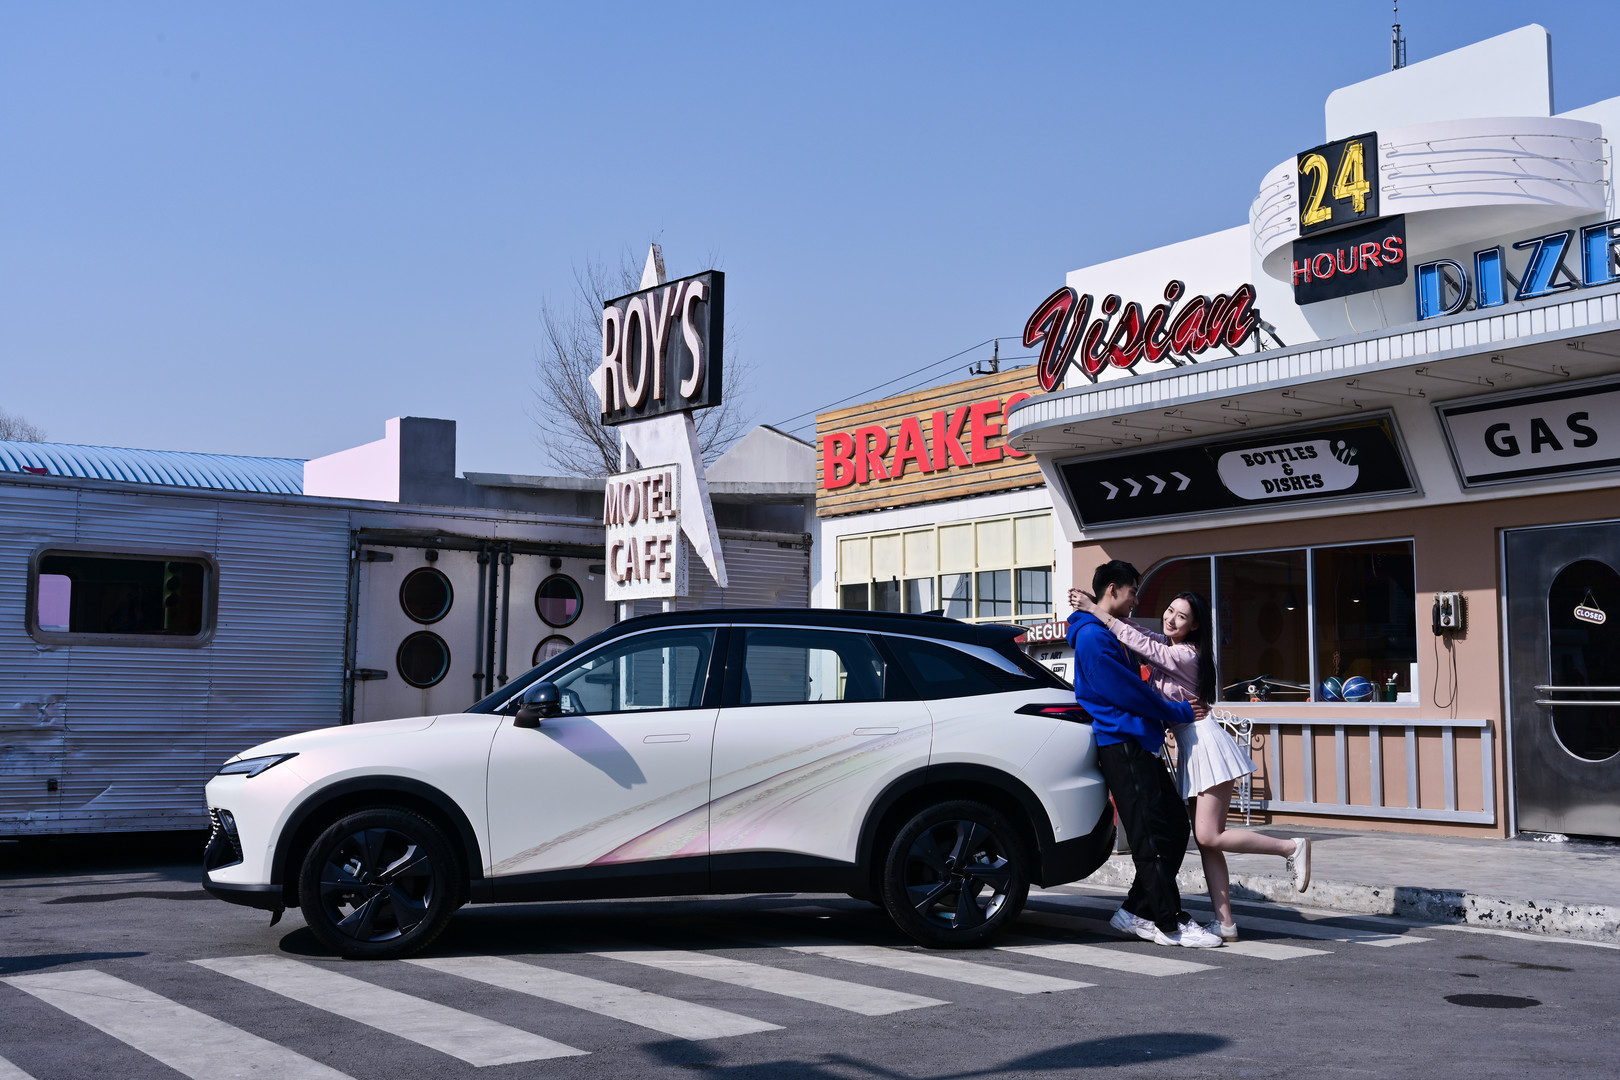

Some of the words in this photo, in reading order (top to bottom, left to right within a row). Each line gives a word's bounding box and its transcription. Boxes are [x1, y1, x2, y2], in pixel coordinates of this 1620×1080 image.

[1299, 140, 1371, 226] 24
[1291, 235, 1404, 286] HOURS
[601, 281, 709, 414] ROY'S
[1240, 445, 1318, 467] BOTTLES
[1484, 411, 1599, 458] GAS
[1260, 473, 1325, 494] DISHES
[1281, 463, 1294, 476] &
[604, 472, 677, 526] MOTEL
[610, 534, 673, 583] CAFE
[1576, 609, 1603, 621] CLOSED
